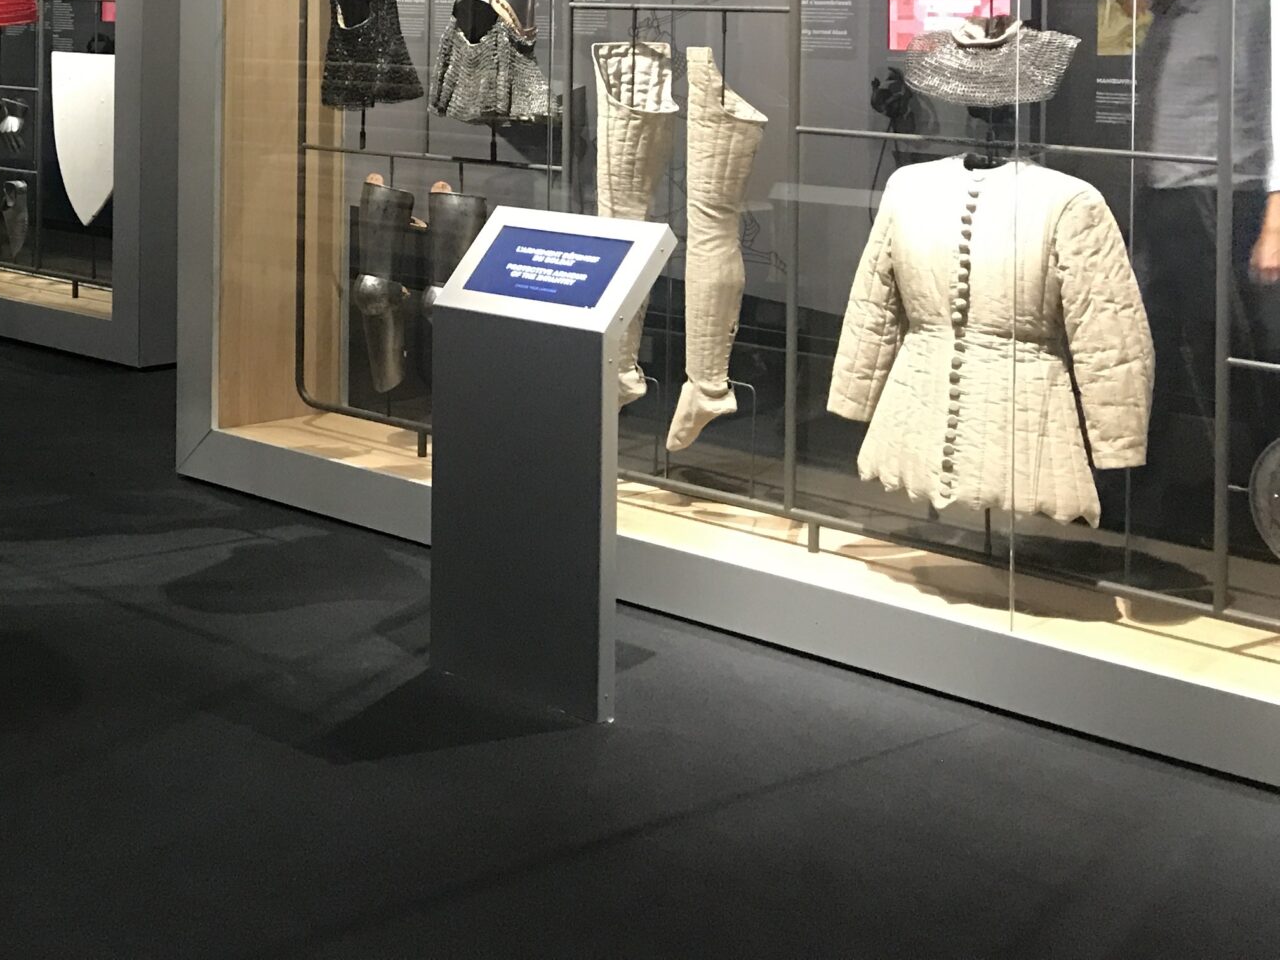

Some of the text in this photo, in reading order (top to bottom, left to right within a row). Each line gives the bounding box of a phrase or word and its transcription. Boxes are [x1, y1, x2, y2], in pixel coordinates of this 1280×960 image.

[505, 262, 554, 276] PROTECTIVE
[510, 270, 523, 278] OF
[521, 272, 538, 280] THE
